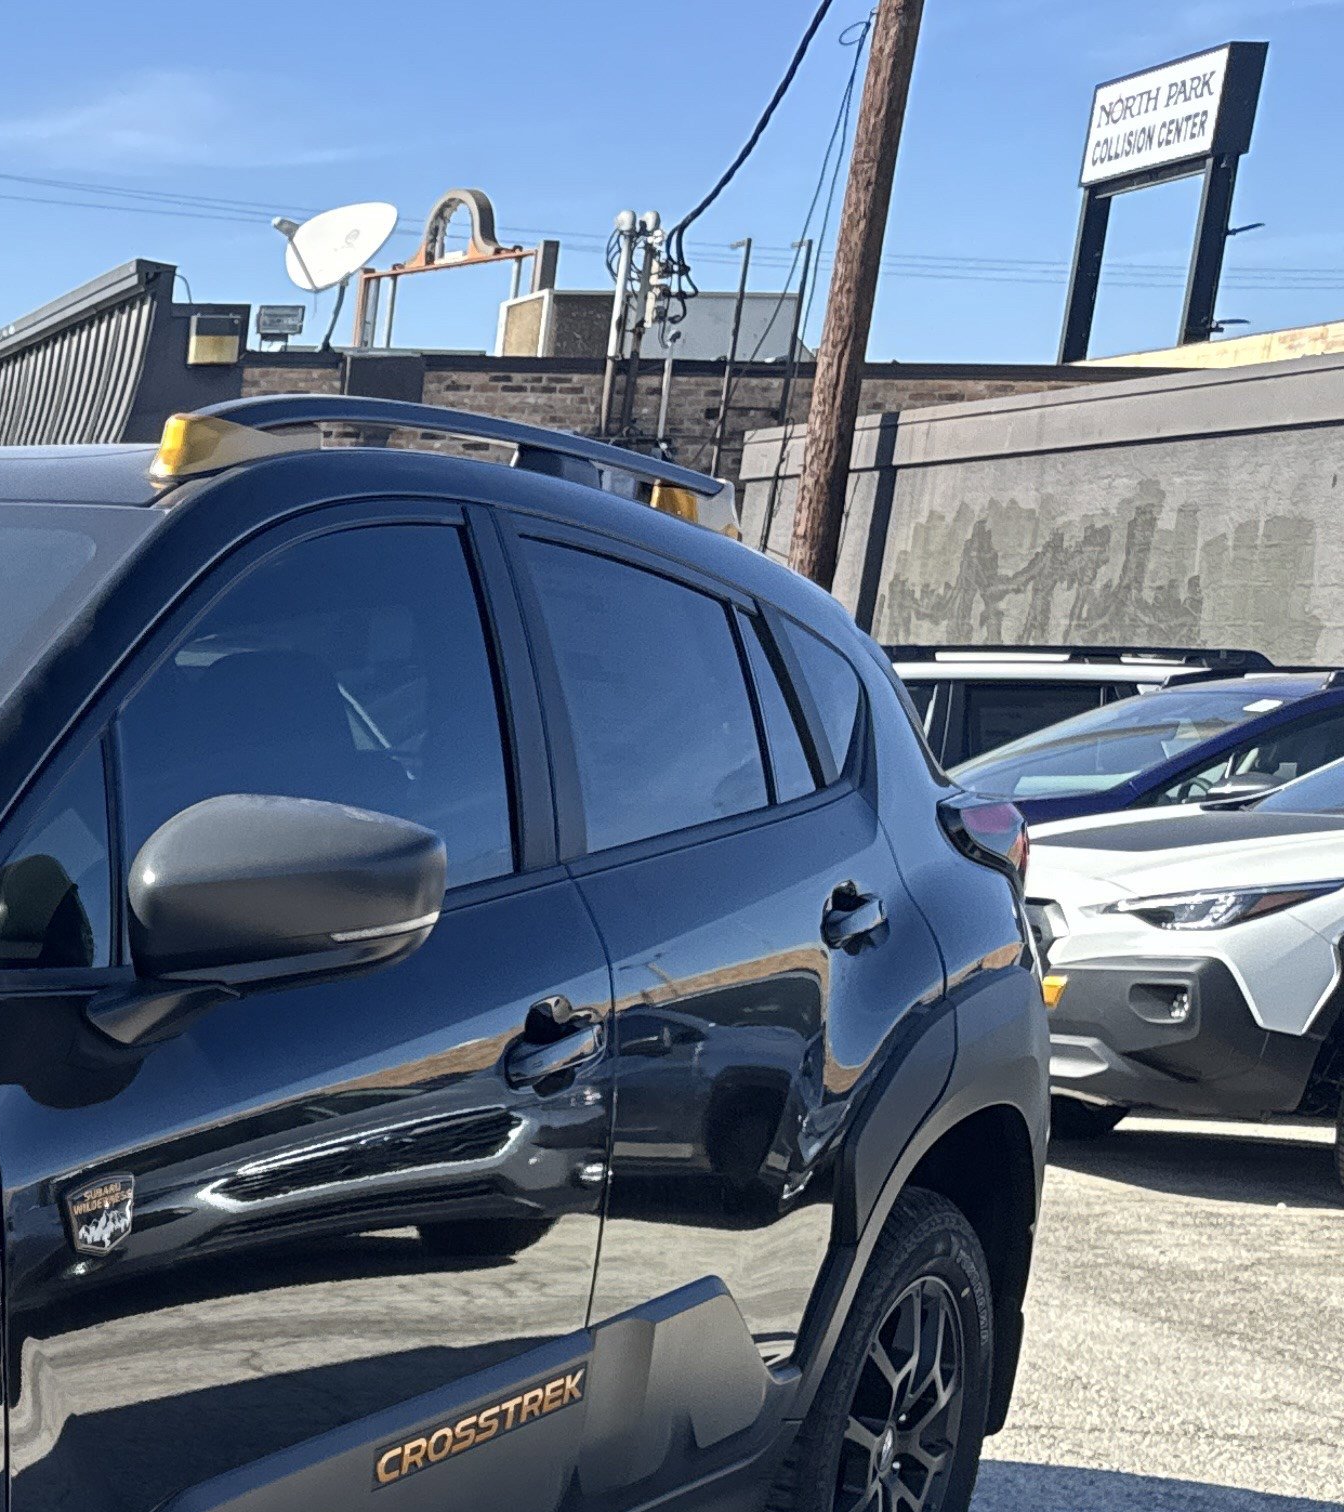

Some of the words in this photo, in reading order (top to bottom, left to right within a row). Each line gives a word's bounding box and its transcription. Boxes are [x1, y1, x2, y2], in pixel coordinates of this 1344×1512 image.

[1096, 86, 1162, 129] NORTH
[1164, 70, 1216, 108] PARK
[1092, 124, 1156, 167] COLLISION
[1157, 110, 1209, 149] CENTER
[376, 1367, 586, 1484] CROSSTREK
